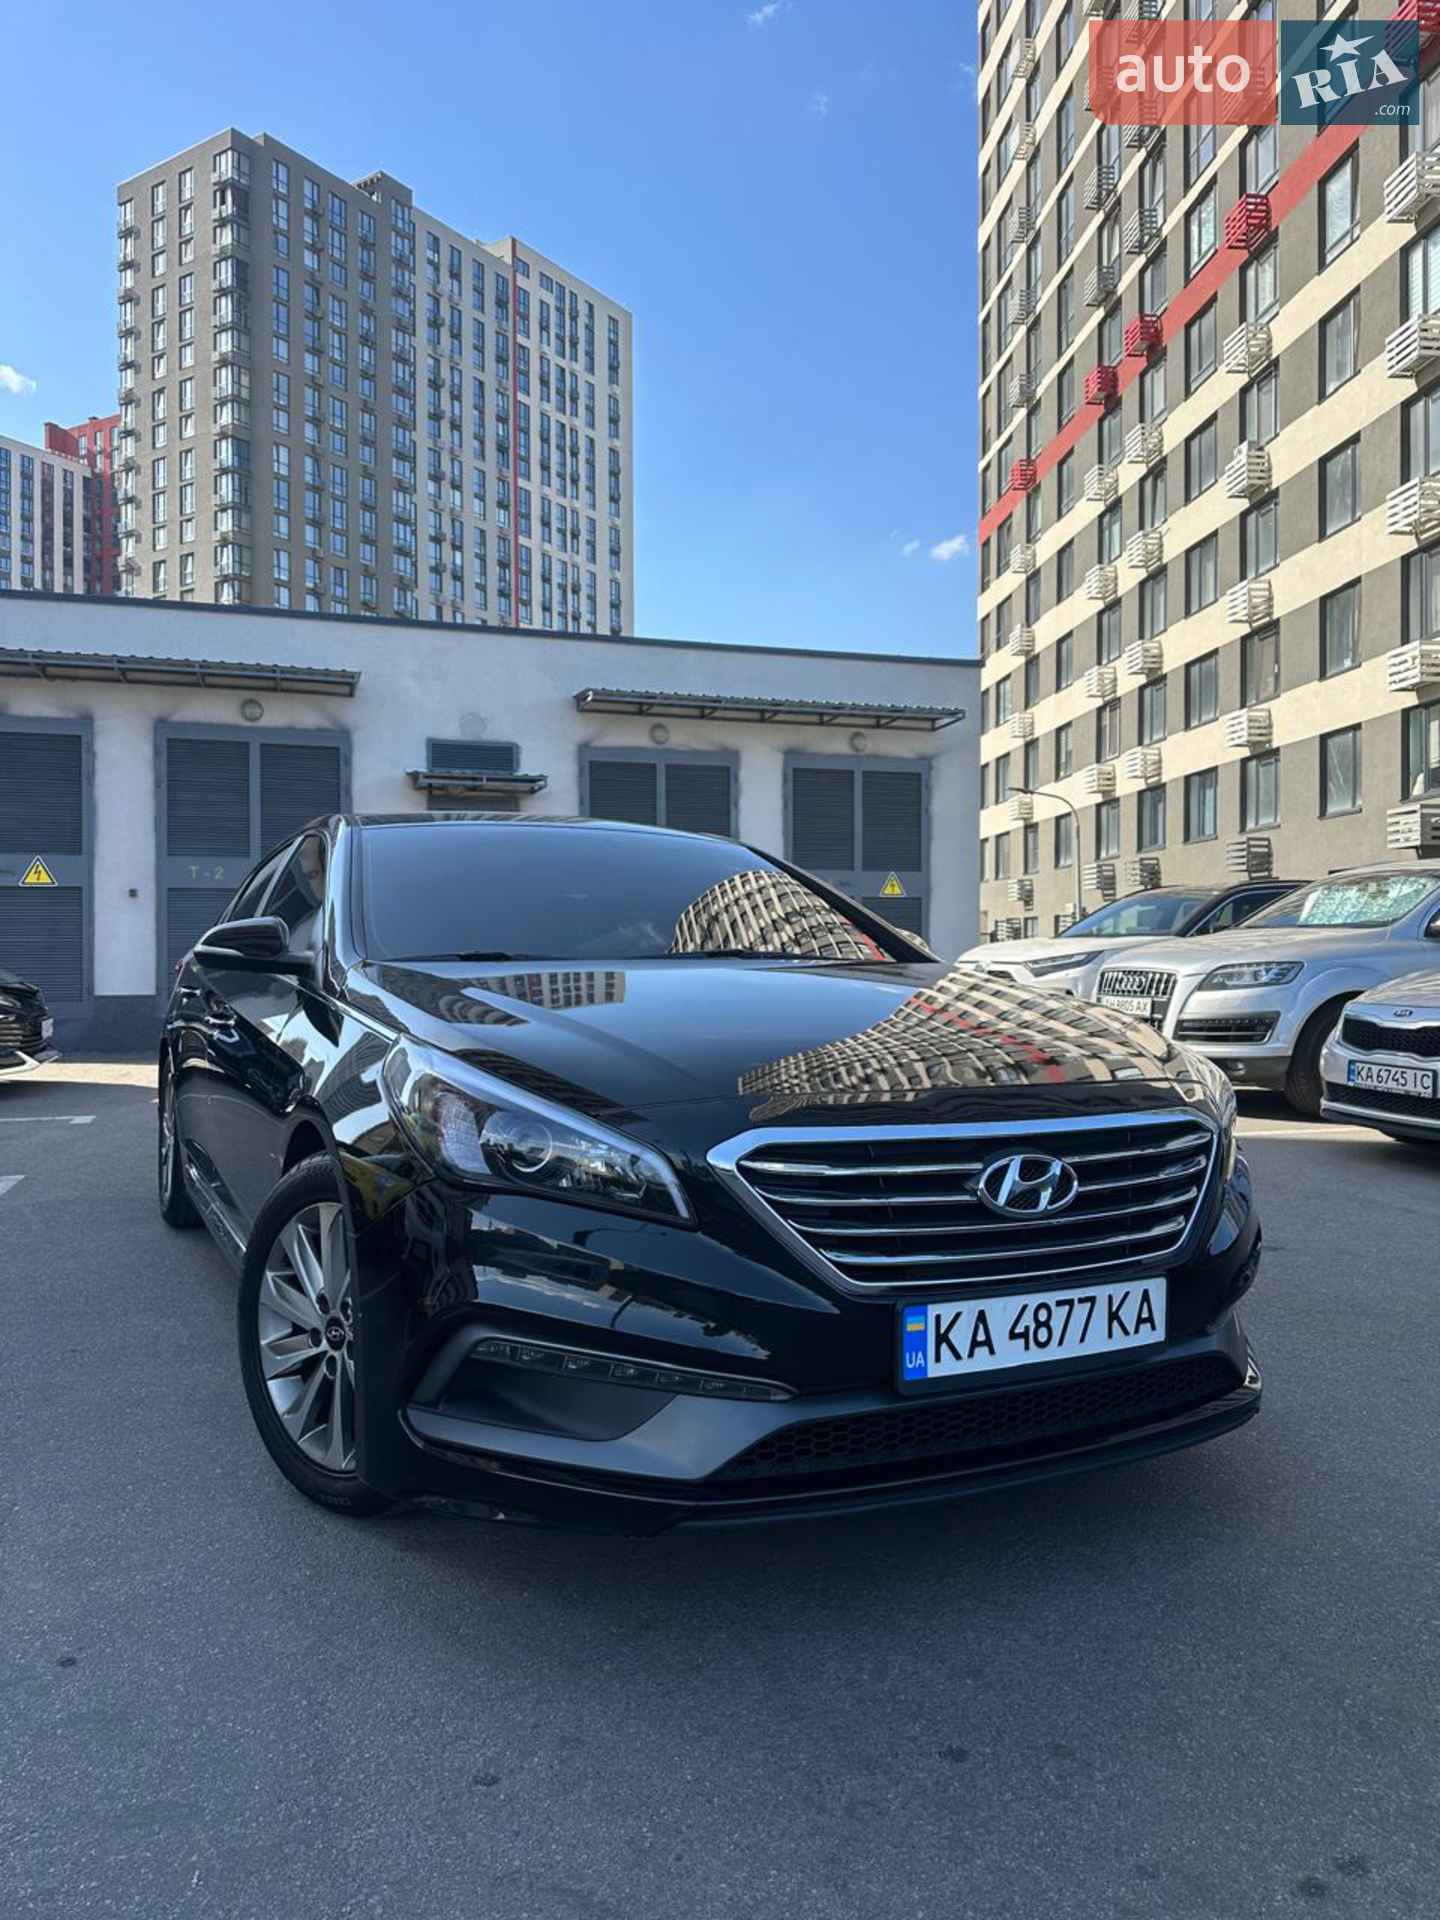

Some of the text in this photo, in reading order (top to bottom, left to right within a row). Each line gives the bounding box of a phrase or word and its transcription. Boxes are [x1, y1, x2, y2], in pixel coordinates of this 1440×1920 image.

[1356, 1065, 1374, 1083] KA
[1376, 1068, 1408, 1087] 6745
[1413, 1072, 1431, 1090] IC
[933, 1288, 1157, 1364] KA 4877 KA
[905, 1351, 926, 1369] UA
